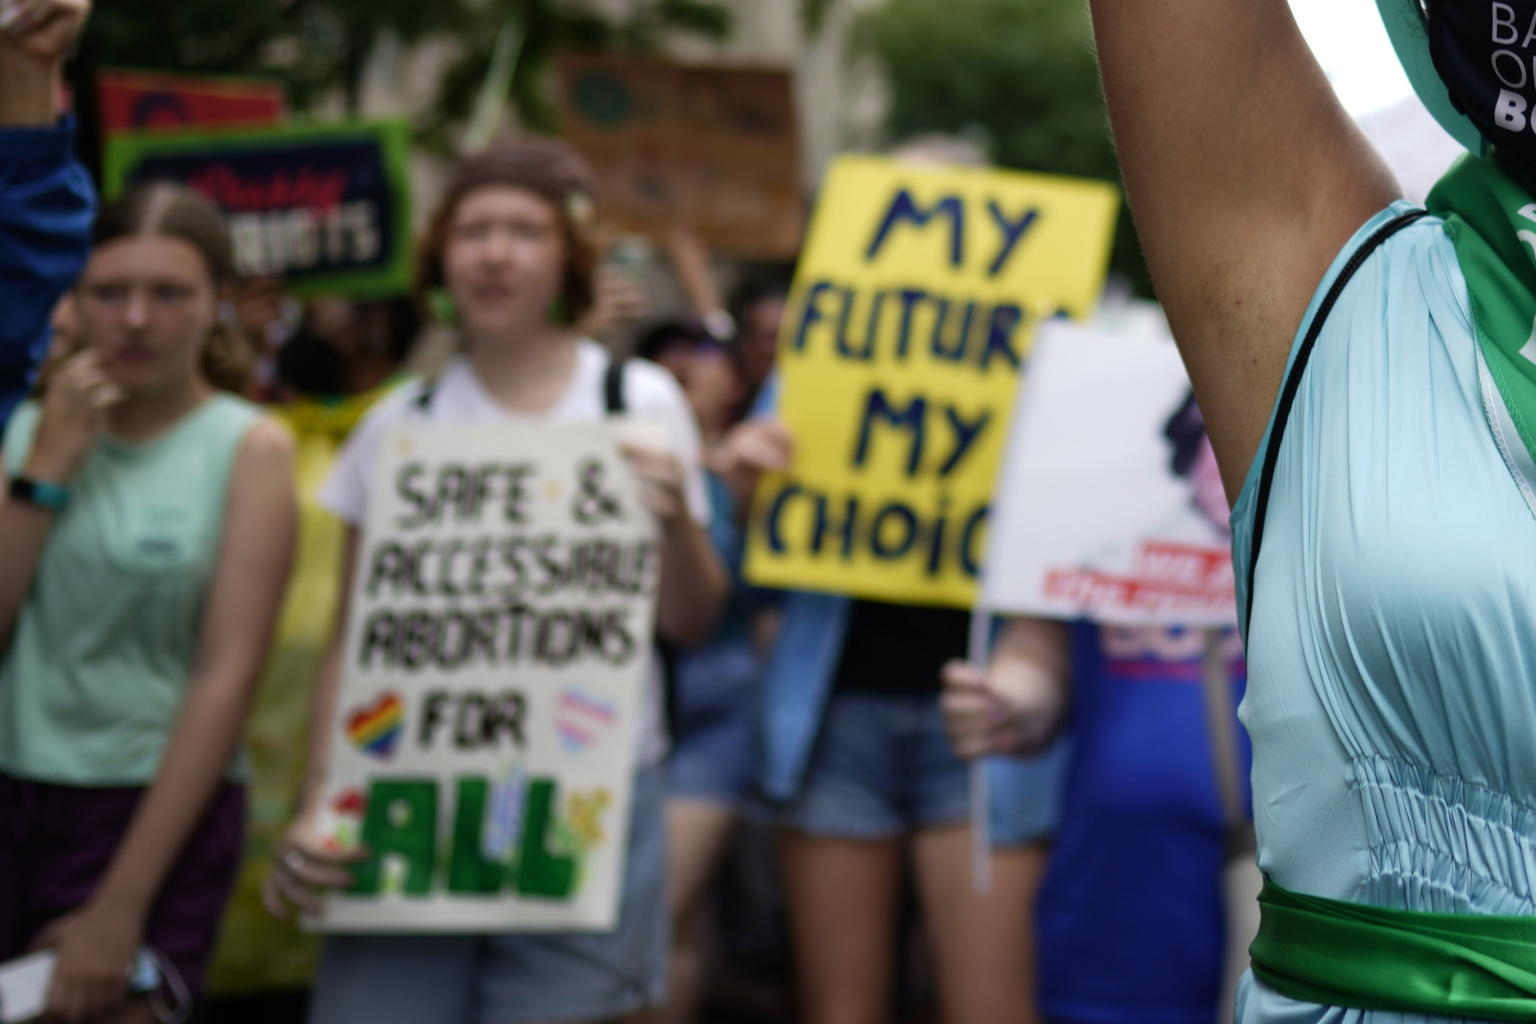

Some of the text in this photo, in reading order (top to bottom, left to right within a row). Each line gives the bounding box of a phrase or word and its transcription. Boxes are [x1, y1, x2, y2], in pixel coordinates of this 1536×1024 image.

[865, 188, 1039, 275] MY
[793, 281, 1024, 372] FUTUR
[854, 390, 992, 478] MY
[396, 453, 624, 529] SAFE &
[769, 484, 990, 578] CHOIC
[366, 534, 658, 598] ACCESSIBLE
[360, 602, 636, 671] ABORTIONS
[418, 687, 528, 750] FOR
[346, 777, 578, 900] ALL
